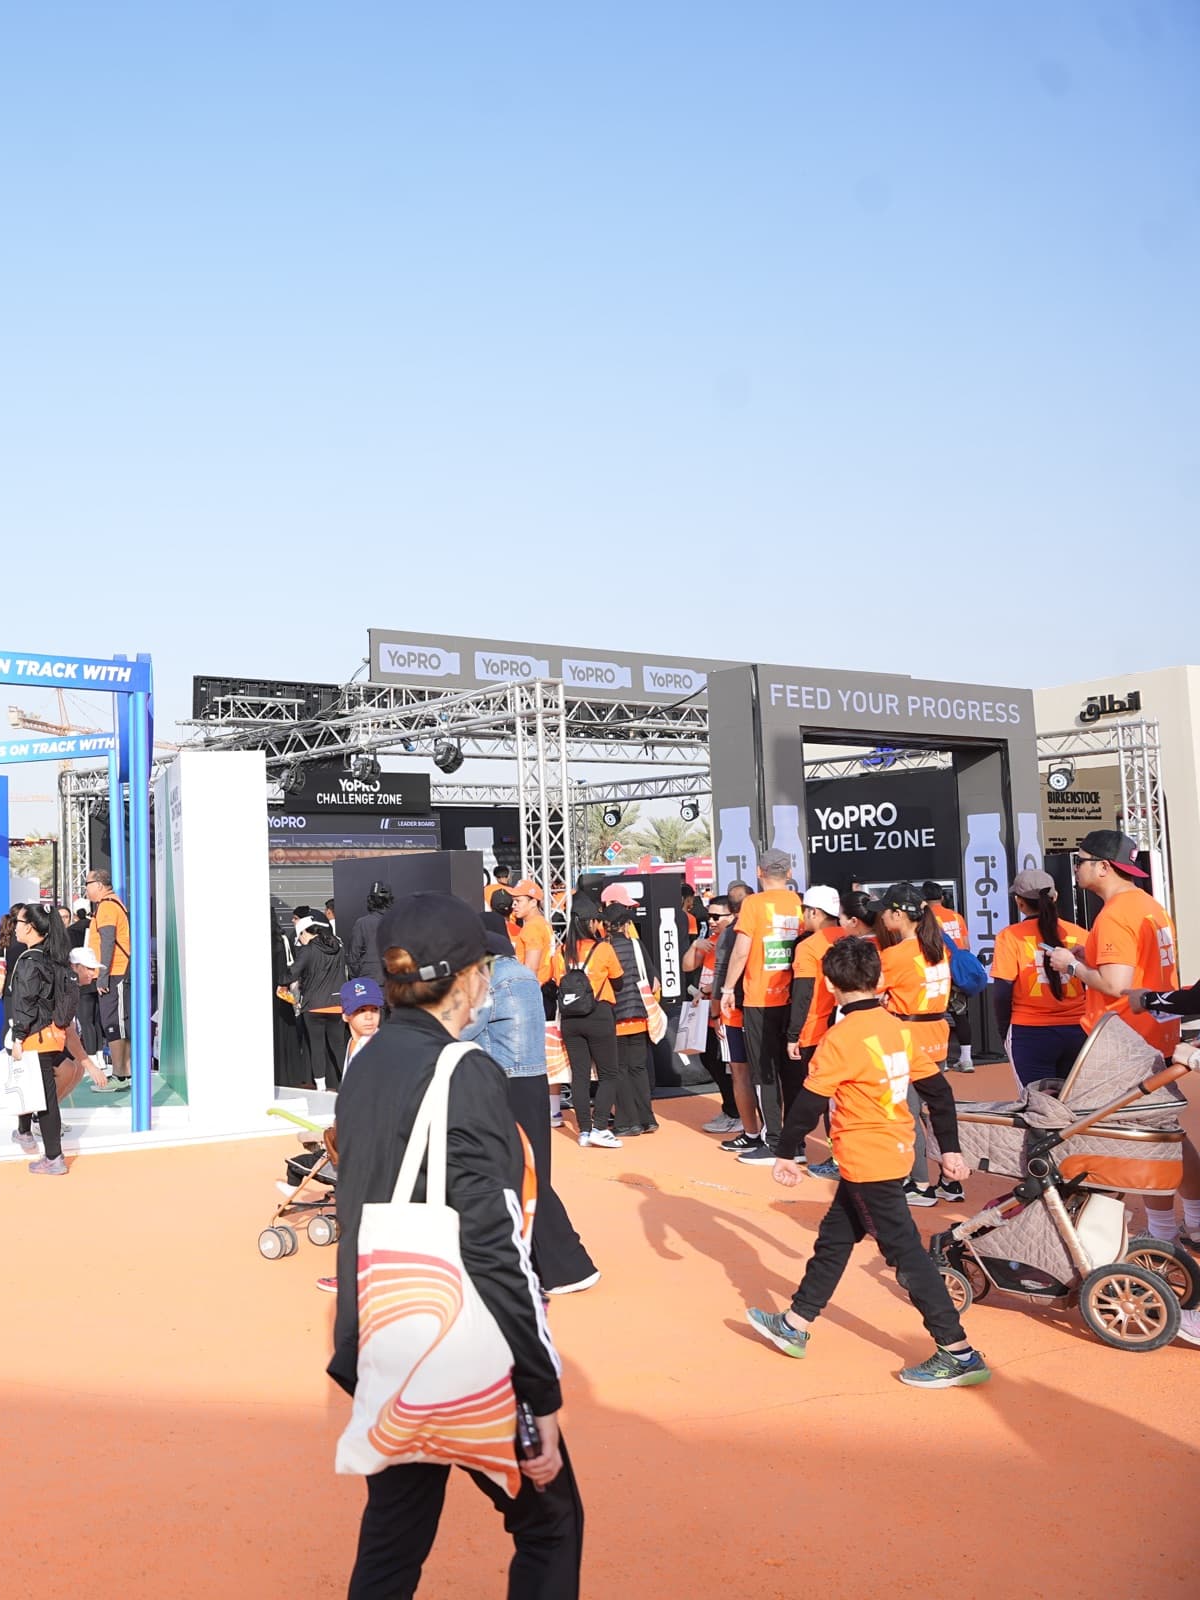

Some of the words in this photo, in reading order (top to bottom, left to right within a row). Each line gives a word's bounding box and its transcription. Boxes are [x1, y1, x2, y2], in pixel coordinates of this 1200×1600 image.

[387, 650, 441, 670] YoPRO
[482, 658, 532, 678] YoPRO
[15, 660, 77, 679] TRACK
[83, 664, 132, 683] WITH
[568, 665, 616, 684] YoPRO
[649, 672, 693, 689] YoPRO
[770, 683, 831, 710] FEED
[838, 689, 900, 716] YOUR
[908, 695, 1021, 724] PROGRESS
[9, 743, 30, 756] ON
[32, 740, 76, 754] TRACK
[78, 737, 115, 750] WITH
[316, 792, 375, 805] CHALLENGE
[377, 794, 403, 805] ZONE
[268, 816, 306, 828] YoPRO
[814, 802, 898, 830] YoPRO
[874, 828, 936, 850] ZONE
